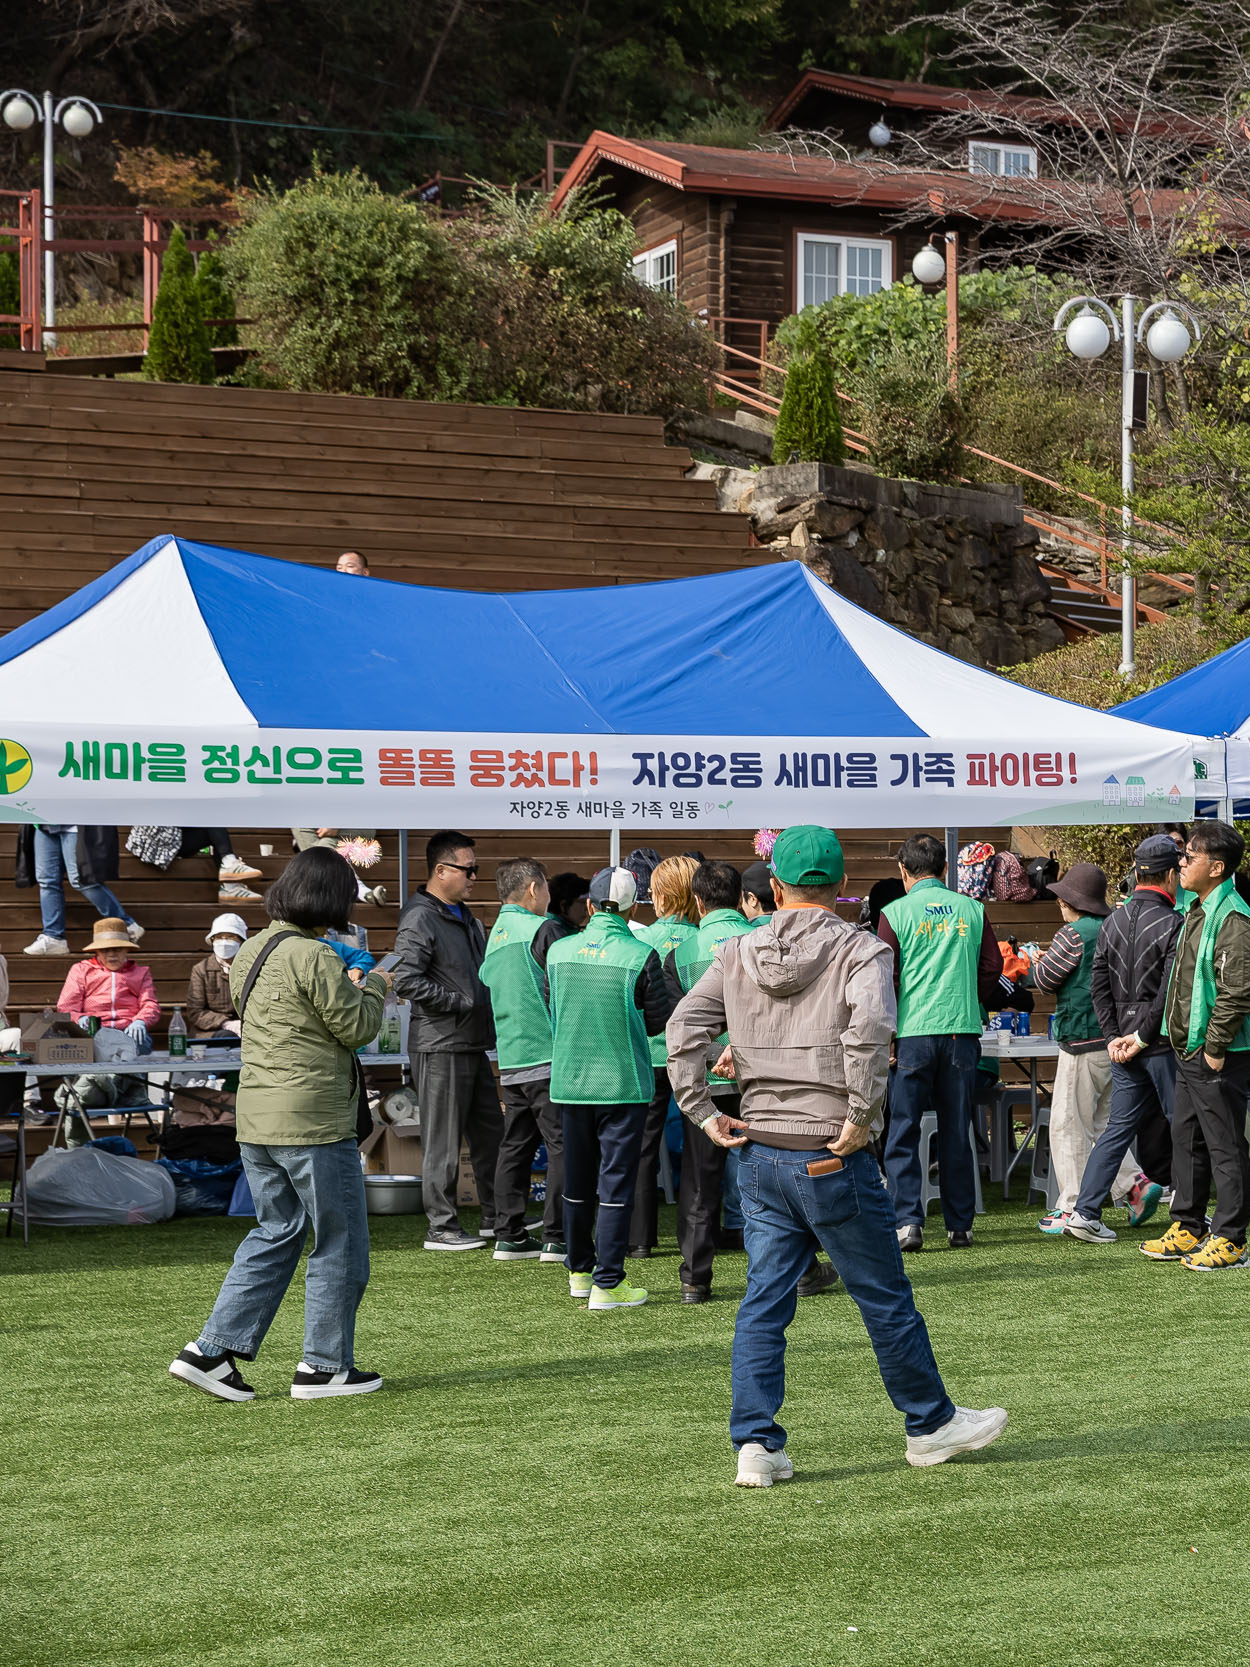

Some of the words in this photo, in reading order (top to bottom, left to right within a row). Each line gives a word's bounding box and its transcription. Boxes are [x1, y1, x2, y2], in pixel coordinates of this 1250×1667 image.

[59, 740, 187, 783] 새마을
[201, 744, 365, 785] 정신으로
[378, 748, 456, 787] 똘똘
[470, 749, 598, 788] 뭉쳤다!
[631, 751, 763, 789] 자양2동
[774, 752, 878, 789] 새마을
[889, 752, 956, 788] 가족
[966, 752, 1078, 787] 파이팅!
[509, 801, 570, 819] 자양2동
[576, 801, 626, 819] 새마을
[631, 801, 664, 819] 가족
[669, 801, 701, 819] 일동
[925, 905, 953, 915] SMU
[915, 918, 968, 940] 새마을
